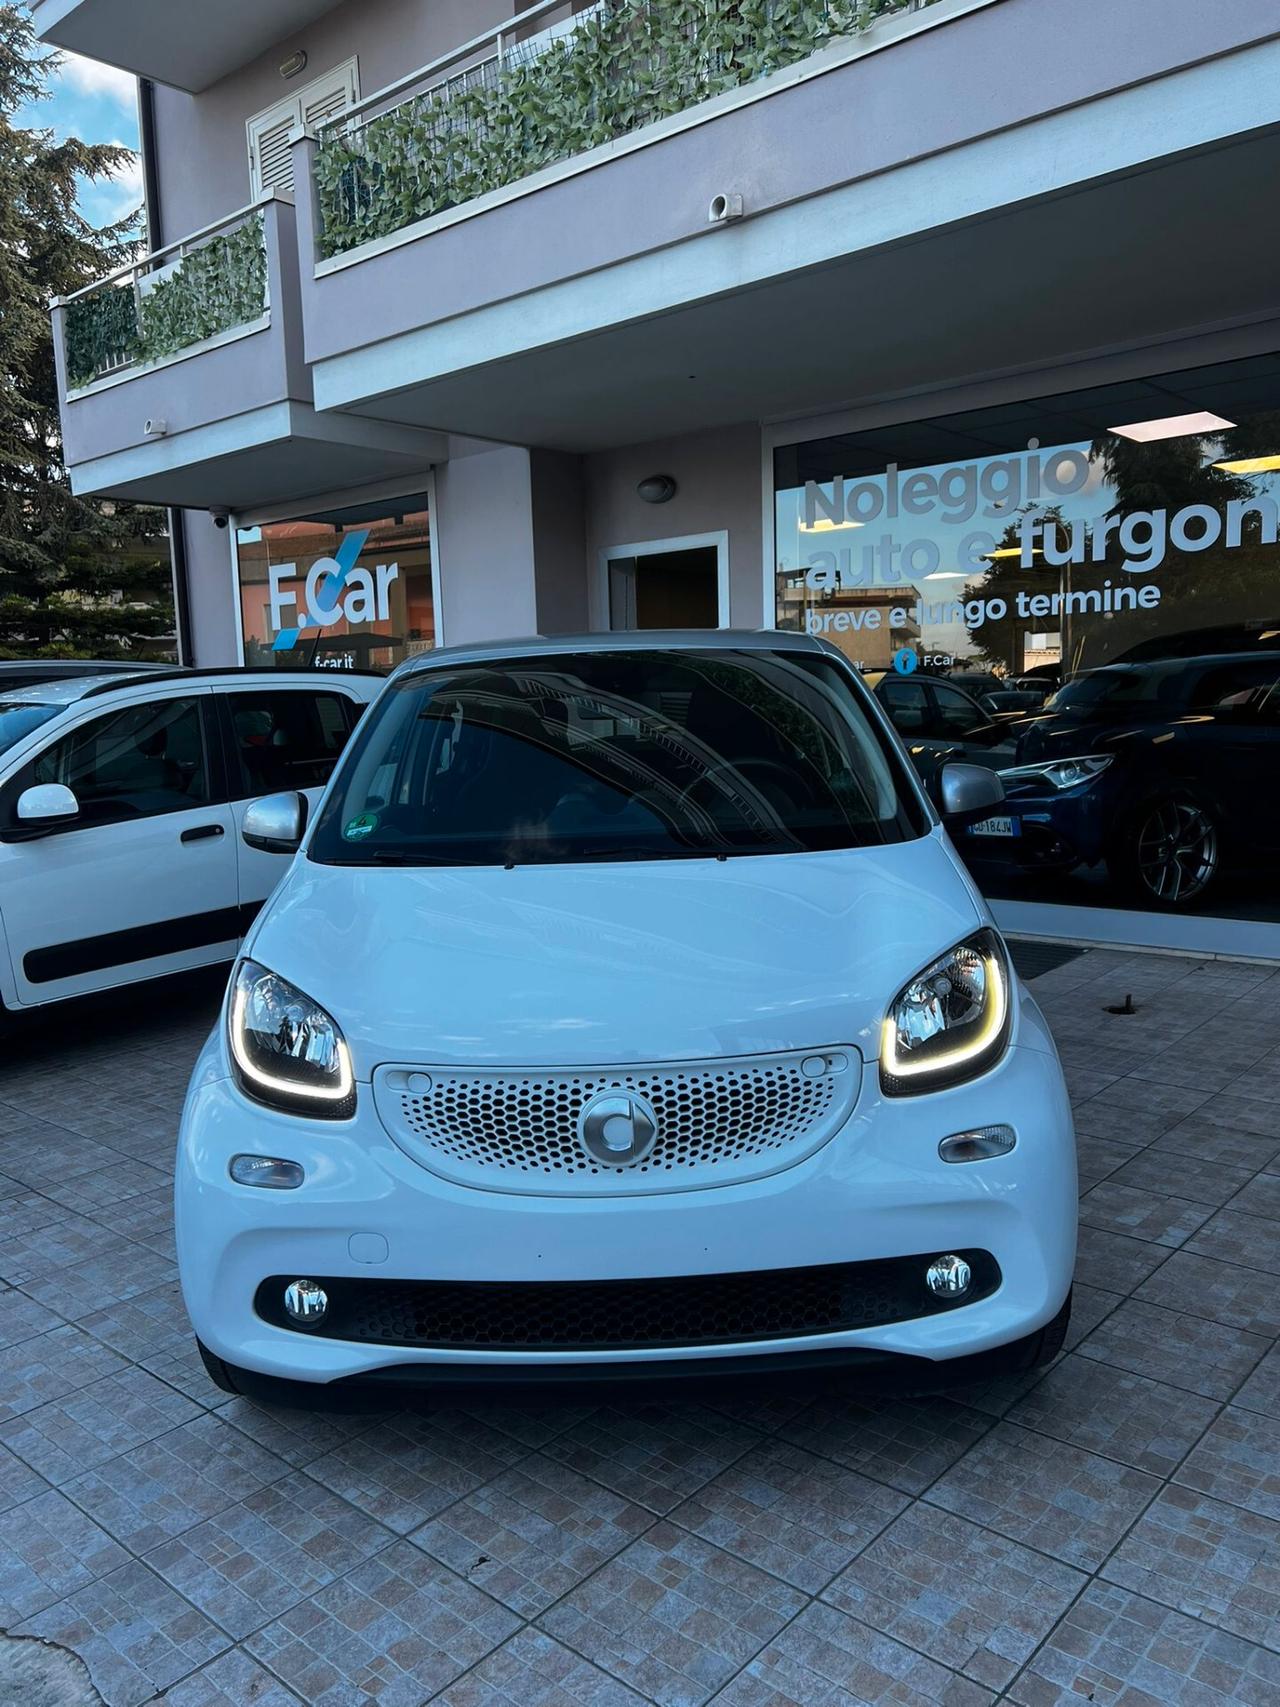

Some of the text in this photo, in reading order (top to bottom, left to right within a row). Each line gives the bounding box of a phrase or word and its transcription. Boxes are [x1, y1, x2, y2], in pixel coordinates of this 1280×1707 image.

[804, 437, 1090, 529] Noleggio
[805, 496, 1278, 594] auto e furgon
[269, 556, 398, 631] F.Car
[806, 580, 1161, 635] breve e lungo termine
[314, 653, 354, 668] f-carit
[923, 654, 955, 667] F.Car
